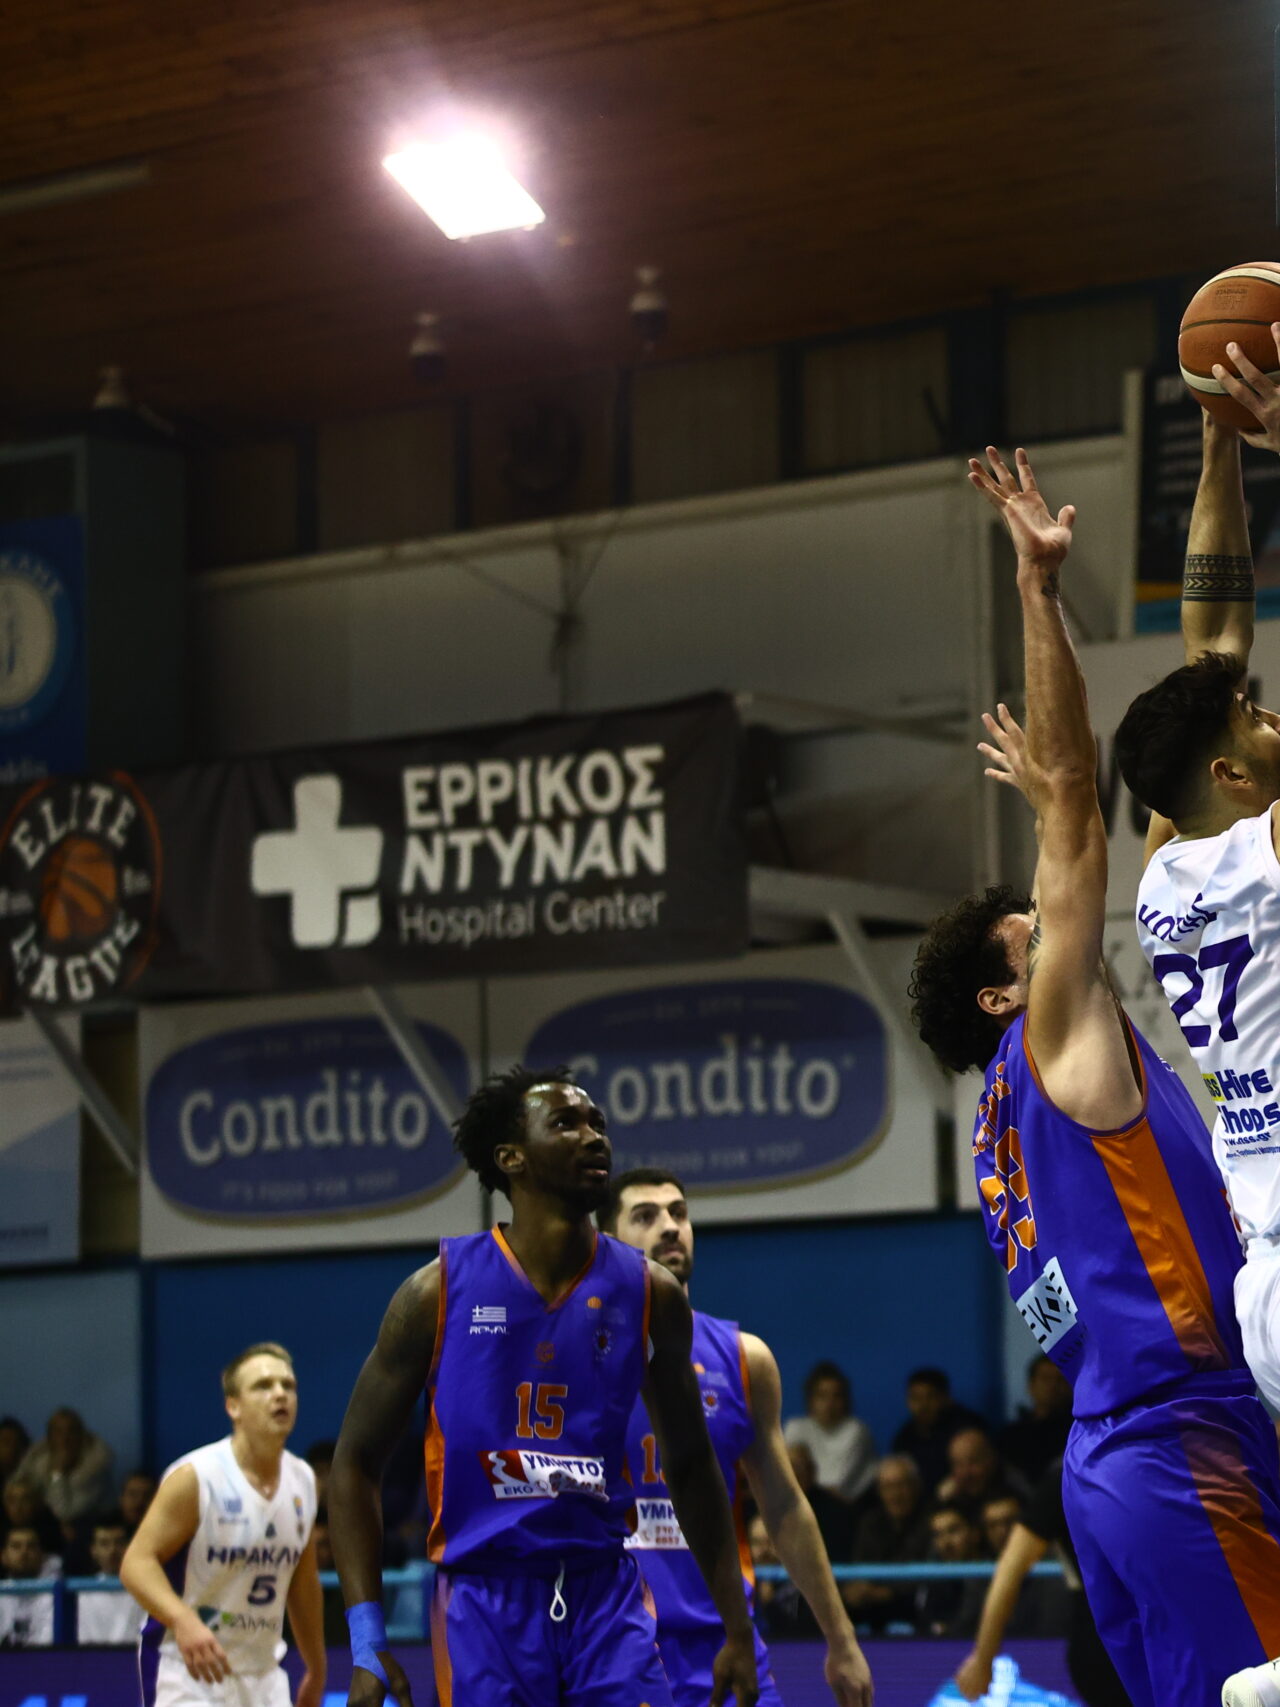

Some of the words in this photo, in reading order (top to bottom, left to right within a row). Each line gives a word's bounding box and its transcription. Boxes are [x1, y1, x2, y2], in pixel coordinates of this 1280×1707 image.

[10, 782, 137, 871] ELITE
[402, 742, 665, 829] ΕΡΡΙΚΟΣ
[401, 809, 667, 896] ΝΤΥΝΑΝ
[10, 910, 142, 1004] LEAGUE
[400, 896, 536, 949] Hospital
[544, 886, 667, 936] Center
[1153, 933, 1255, 1048] 27
[178, 1066, 431, 1167] Condito
[1214, 1068, 1274, 1101] Hire
[515, 1380, 569, 1440] 15
[503, 1484, 534, 1496] EKO
[248, 1575, 276, 1606] 5
